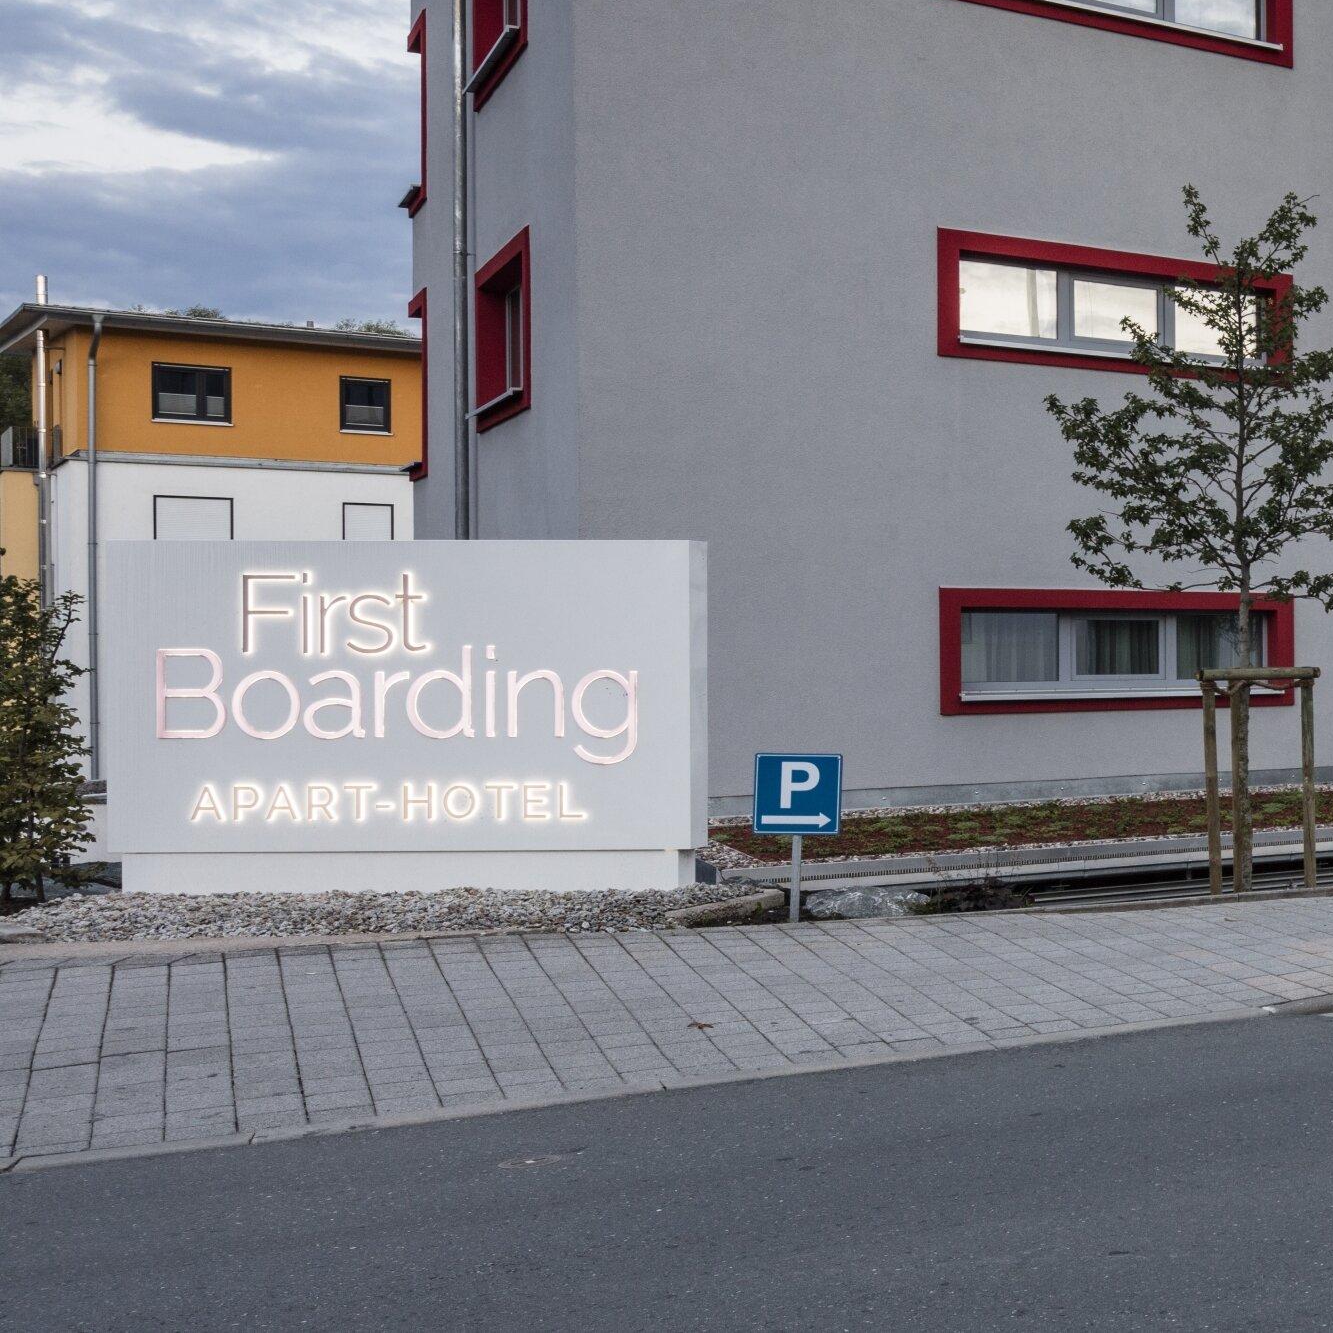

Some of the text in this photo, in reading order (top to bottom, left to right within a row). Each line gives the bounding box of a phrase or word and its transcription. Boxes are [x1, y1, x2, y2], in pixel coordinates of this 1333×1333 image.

[242, 571, 431, 655] First
[155, 644, 639, 766] Boarding
[190, 782, 587, 822] APART-HOTEL
[779, 761, 821, 809] P
